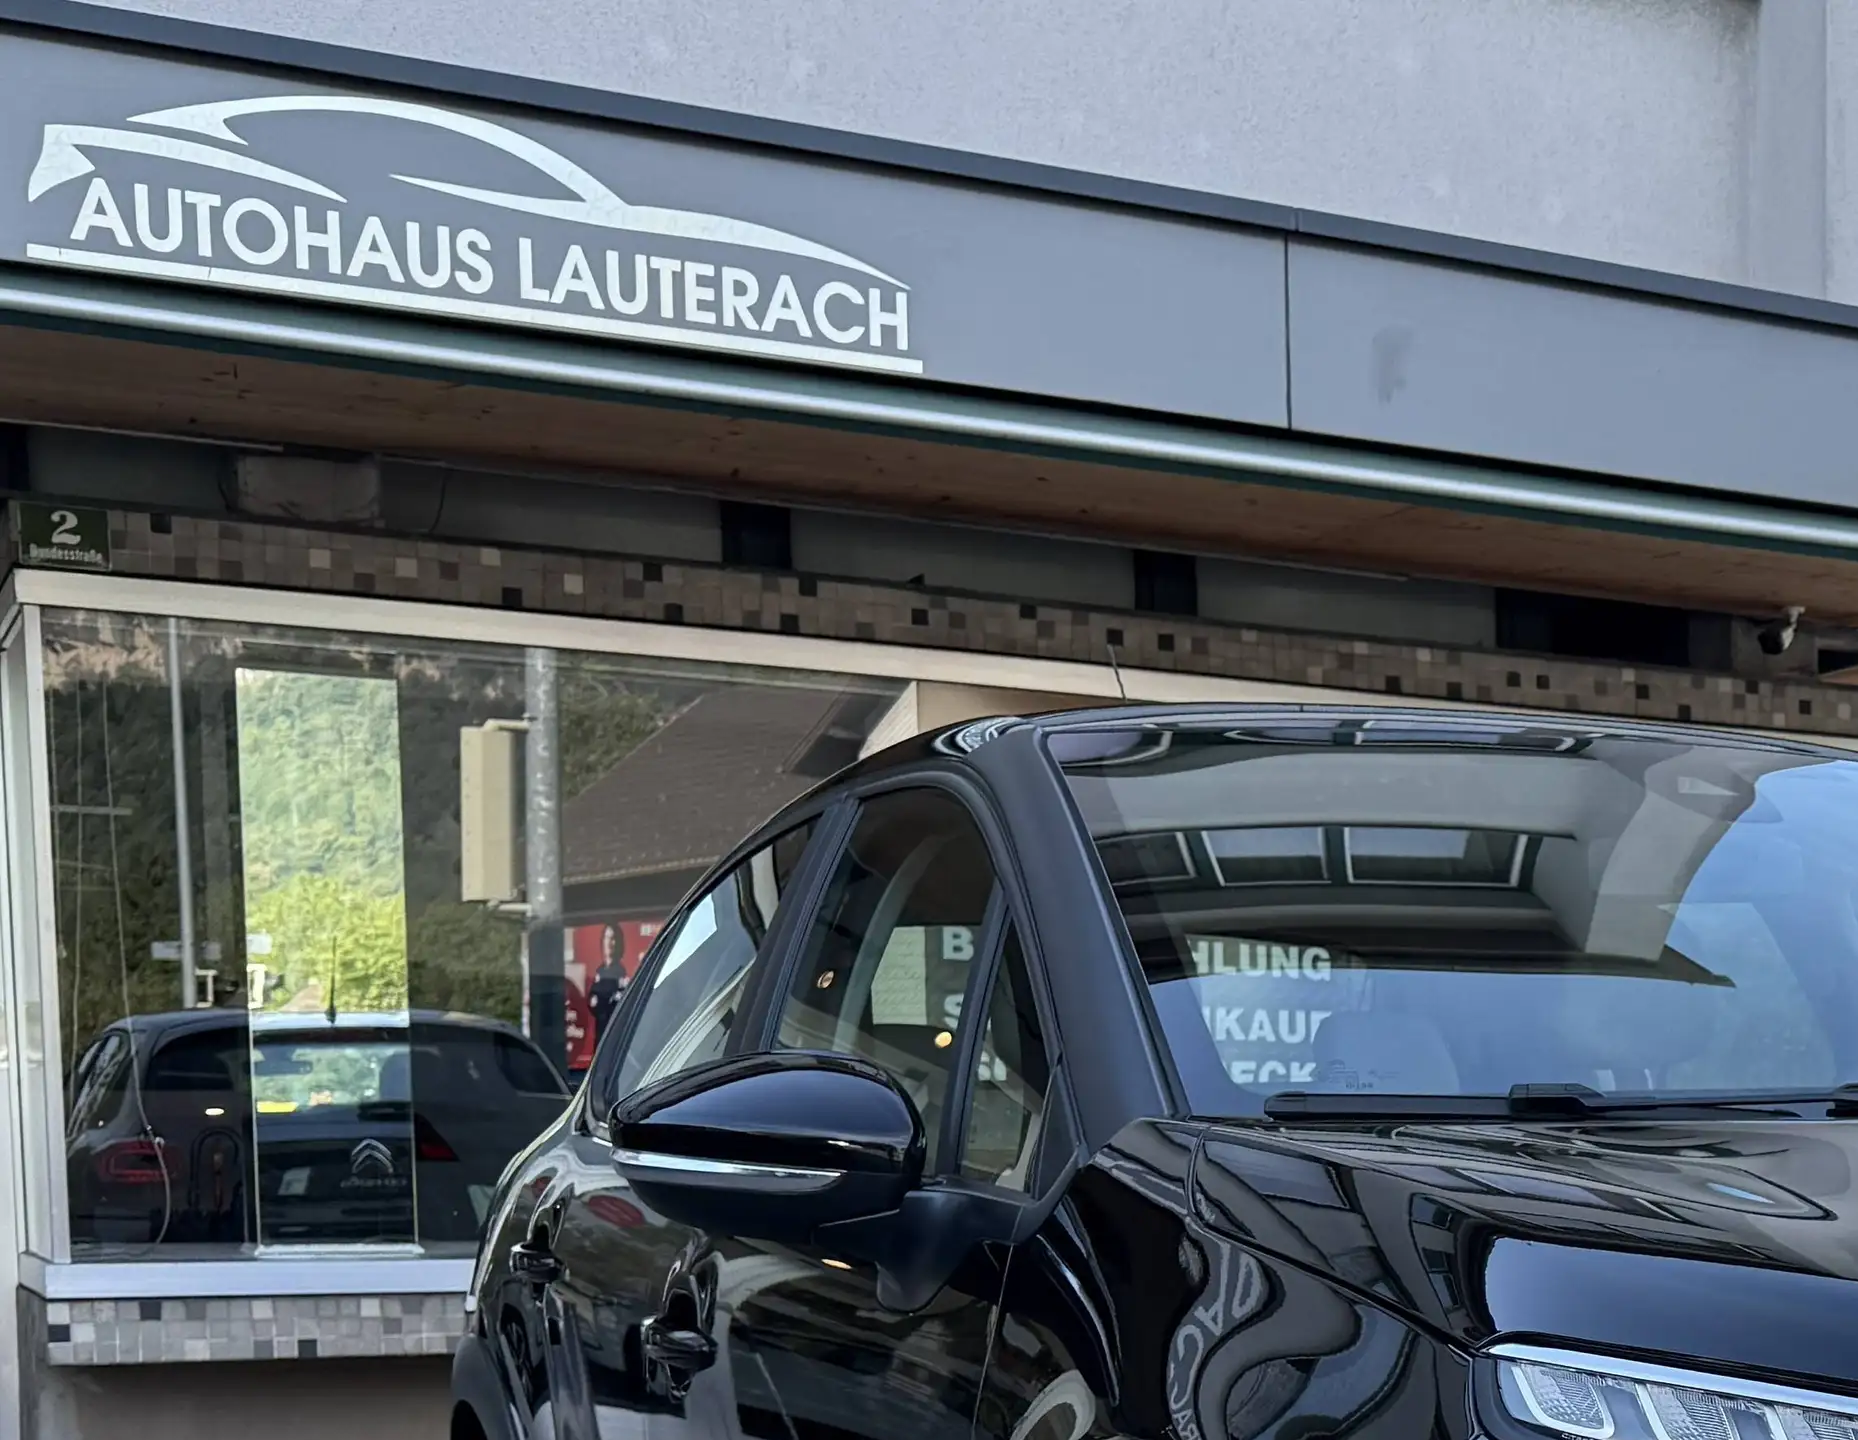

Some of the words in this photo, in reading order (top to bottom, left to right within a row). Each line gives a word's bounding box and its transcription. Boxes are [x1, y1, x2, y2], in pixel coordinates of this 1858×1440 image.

[69, 177, 494, 295] AUTOHAUS
[519, 237, 910, 351] LAUTERACH
[50, 510, 81, 545] 2
[1191, 941, 1332, 981] HLUNG
